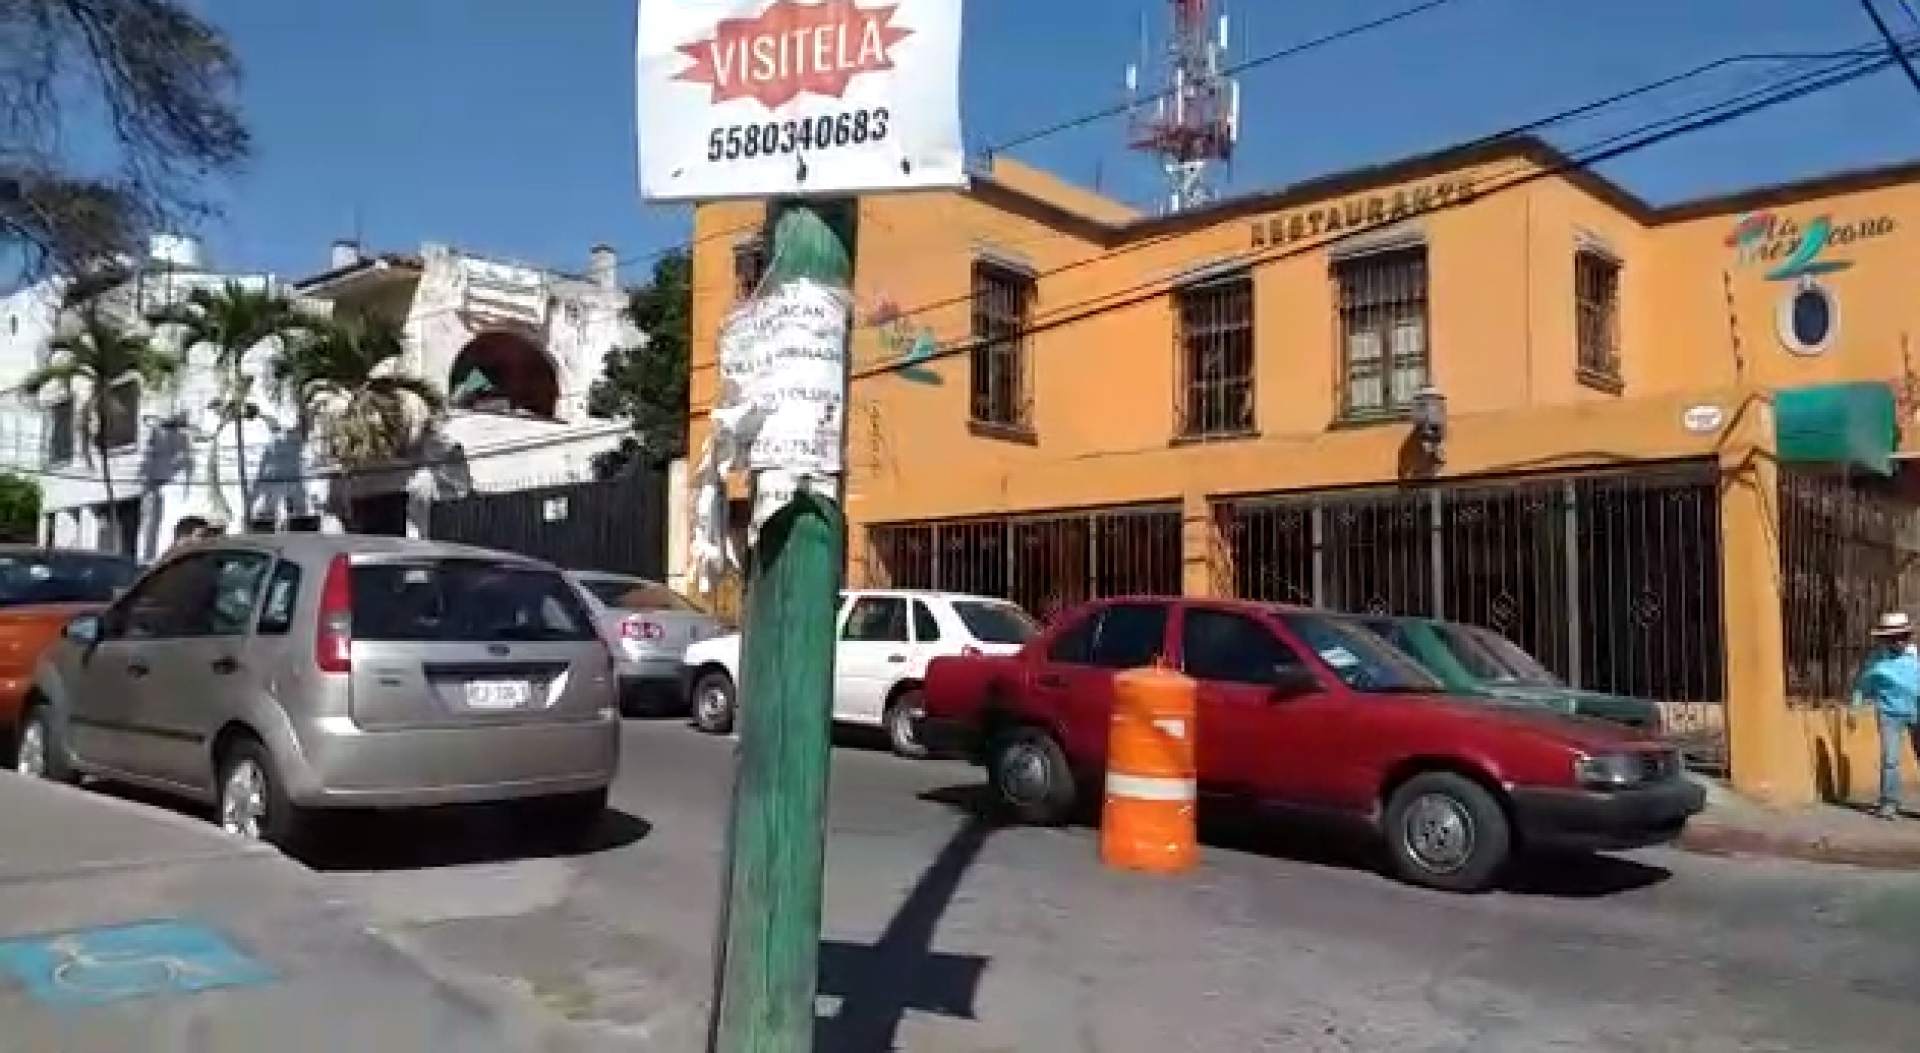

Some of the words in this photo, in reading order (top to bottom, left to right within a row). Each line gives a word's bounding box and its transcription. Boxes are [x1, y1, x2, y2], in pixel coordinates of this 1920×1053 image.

[709, 18, 884, 87] VISITELA
[707, 106, 890, 162] 5580340683
[1250, 174, 1477, 248] RESTAURANTE
